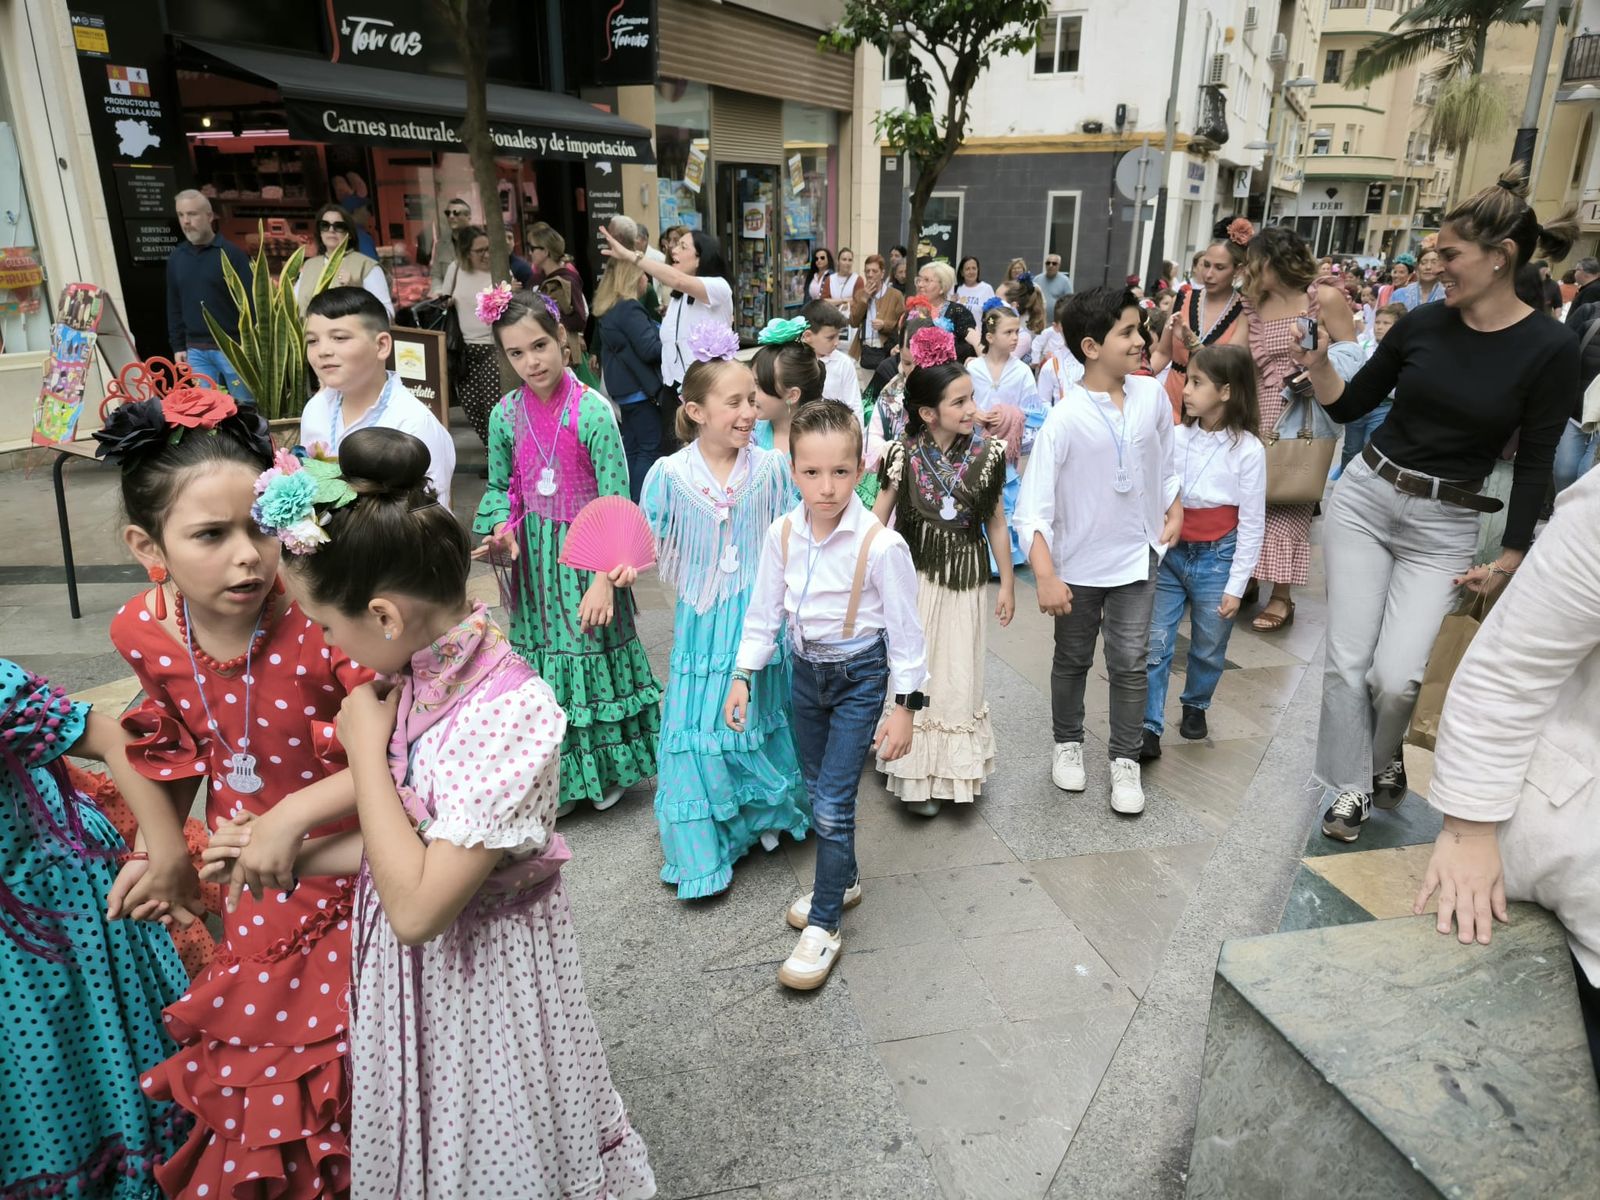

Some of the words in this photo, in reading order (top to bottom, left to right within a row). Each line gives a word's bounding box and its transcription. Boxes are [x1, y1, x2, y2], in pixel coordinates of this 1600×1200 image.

[104, 97, 149, 108] PRODUCTOS
[149, 101, 160, 109] DE
[105, 106, 162, 118] CASTILLA-LEÓN
[322, 110, 387, 136] Carnes
[488, 127, 538, 150] ionales
[539, 136, 549, 155] y
[550, 132, 565, 151] de
[566, 135, 637, 159] importación
